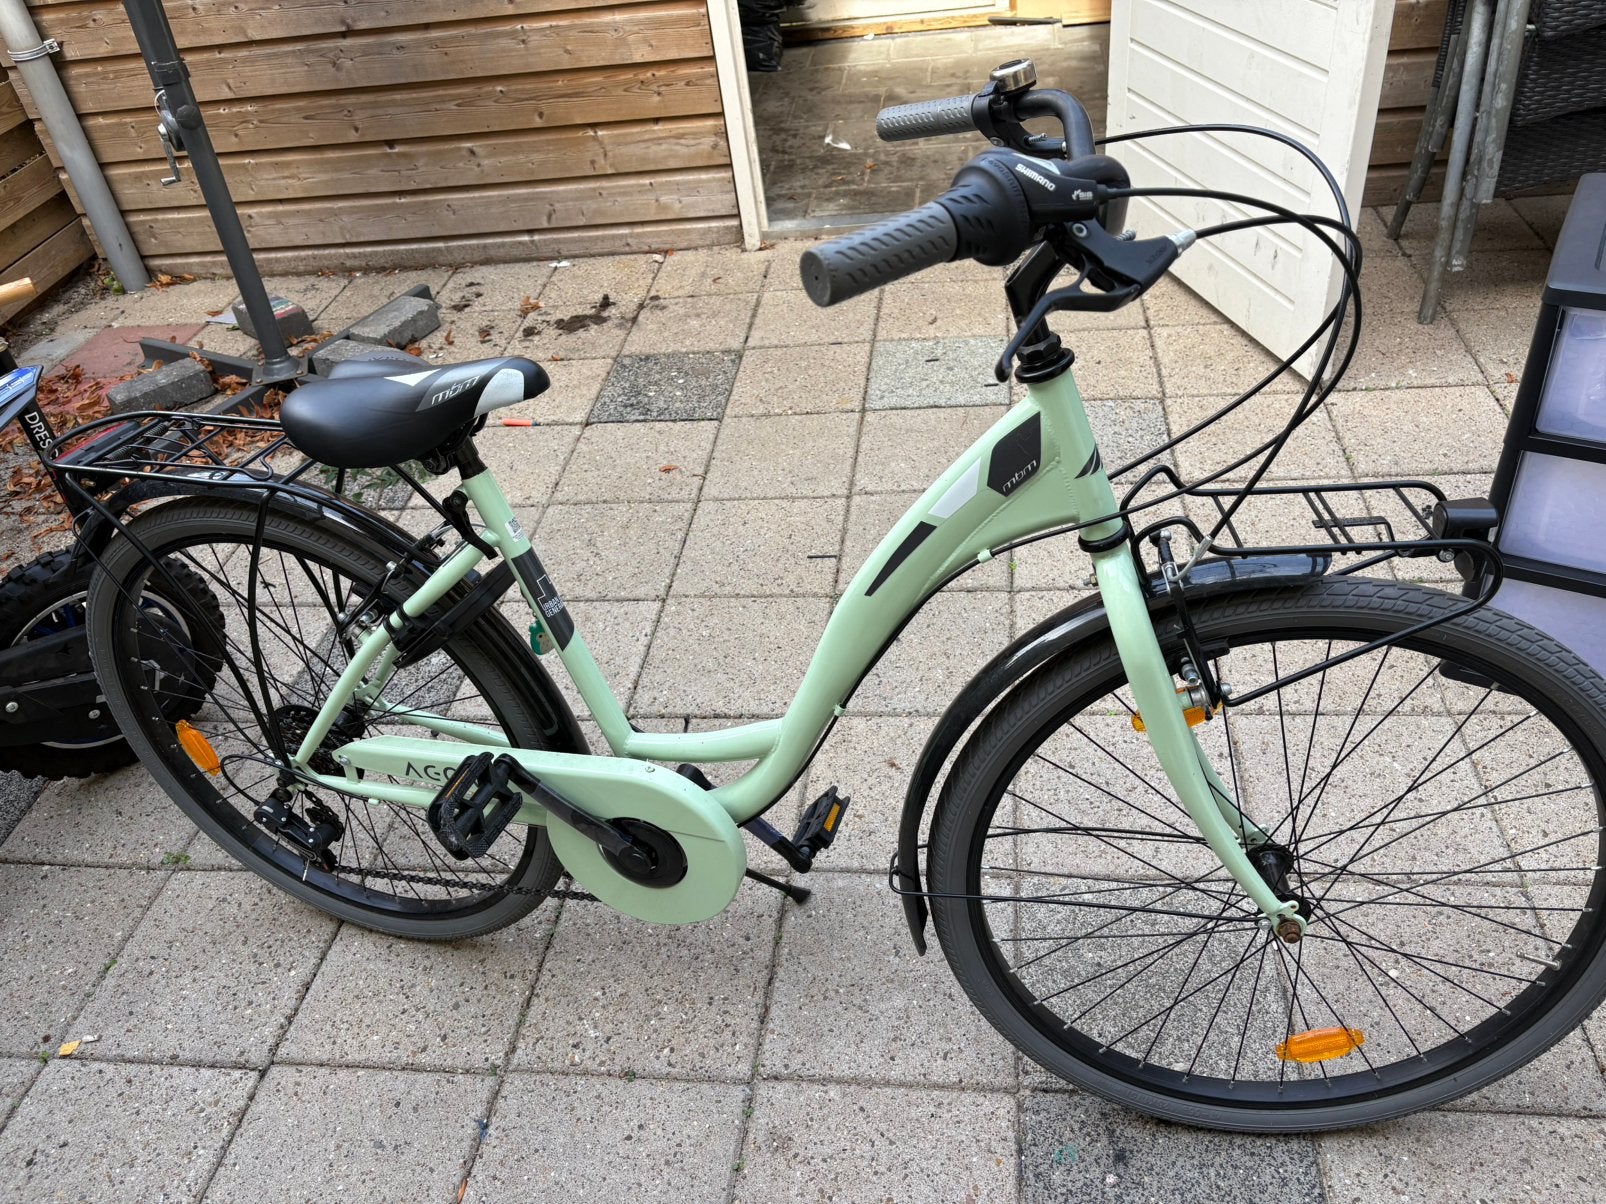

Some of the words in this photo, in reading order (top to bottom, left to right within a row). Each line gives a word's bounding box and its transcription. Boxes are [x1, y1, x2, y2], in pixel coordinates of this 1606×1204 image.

[1015, 163, 1056, 191] SHIMANO
[431, 375, 480, 405] mbm
[1002, 459, 1036, 492] mbm
